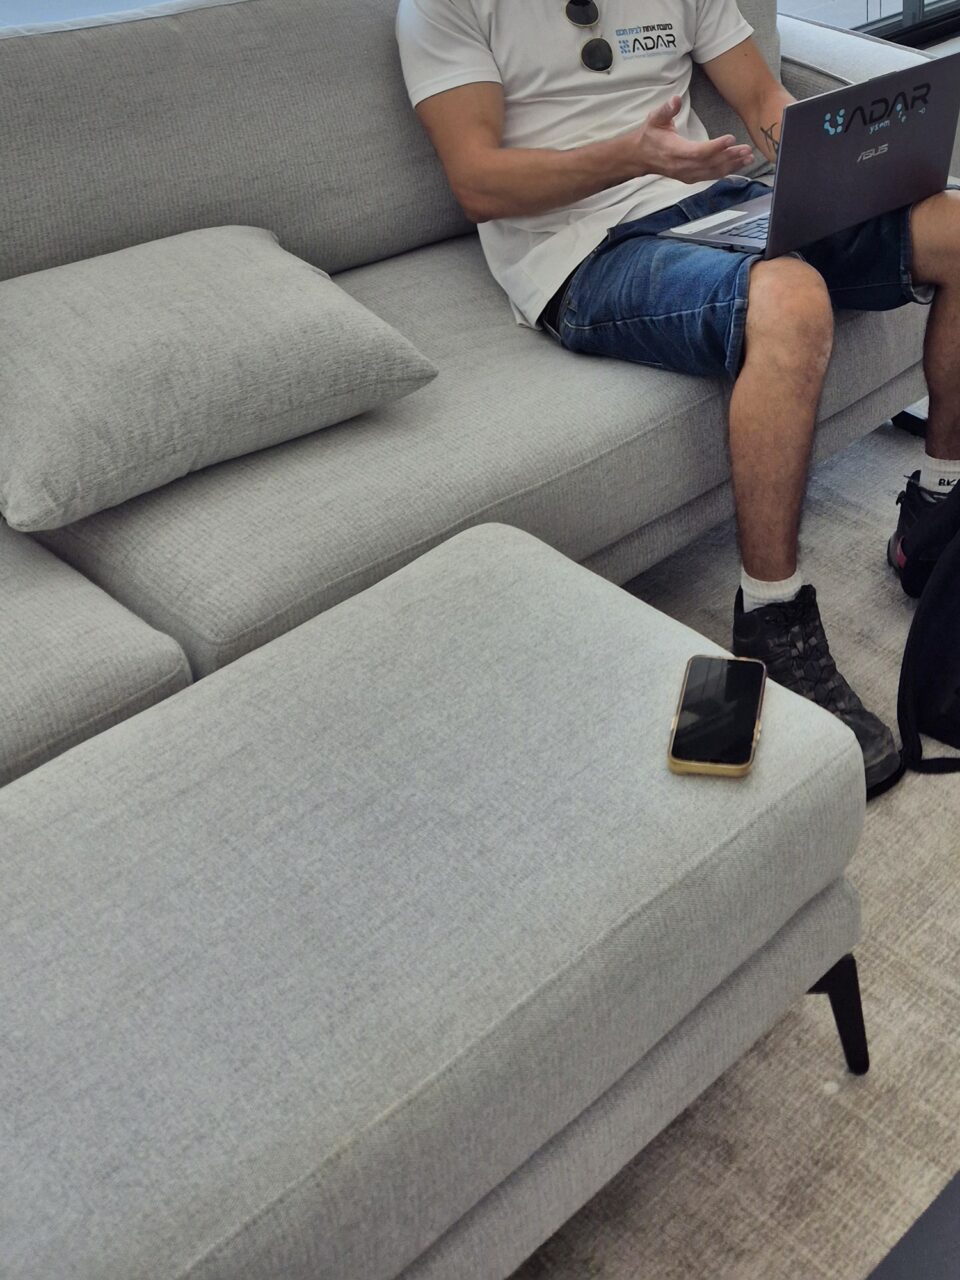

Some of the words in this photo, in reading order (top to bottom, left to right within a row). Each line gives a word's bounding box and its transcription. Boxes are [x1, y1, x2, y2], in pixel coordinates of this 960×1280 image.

[632, 33, 677, 53] ADAR
[844, 83, 931, 132] ADAR
[857, 144, 889, 162] ASUS
